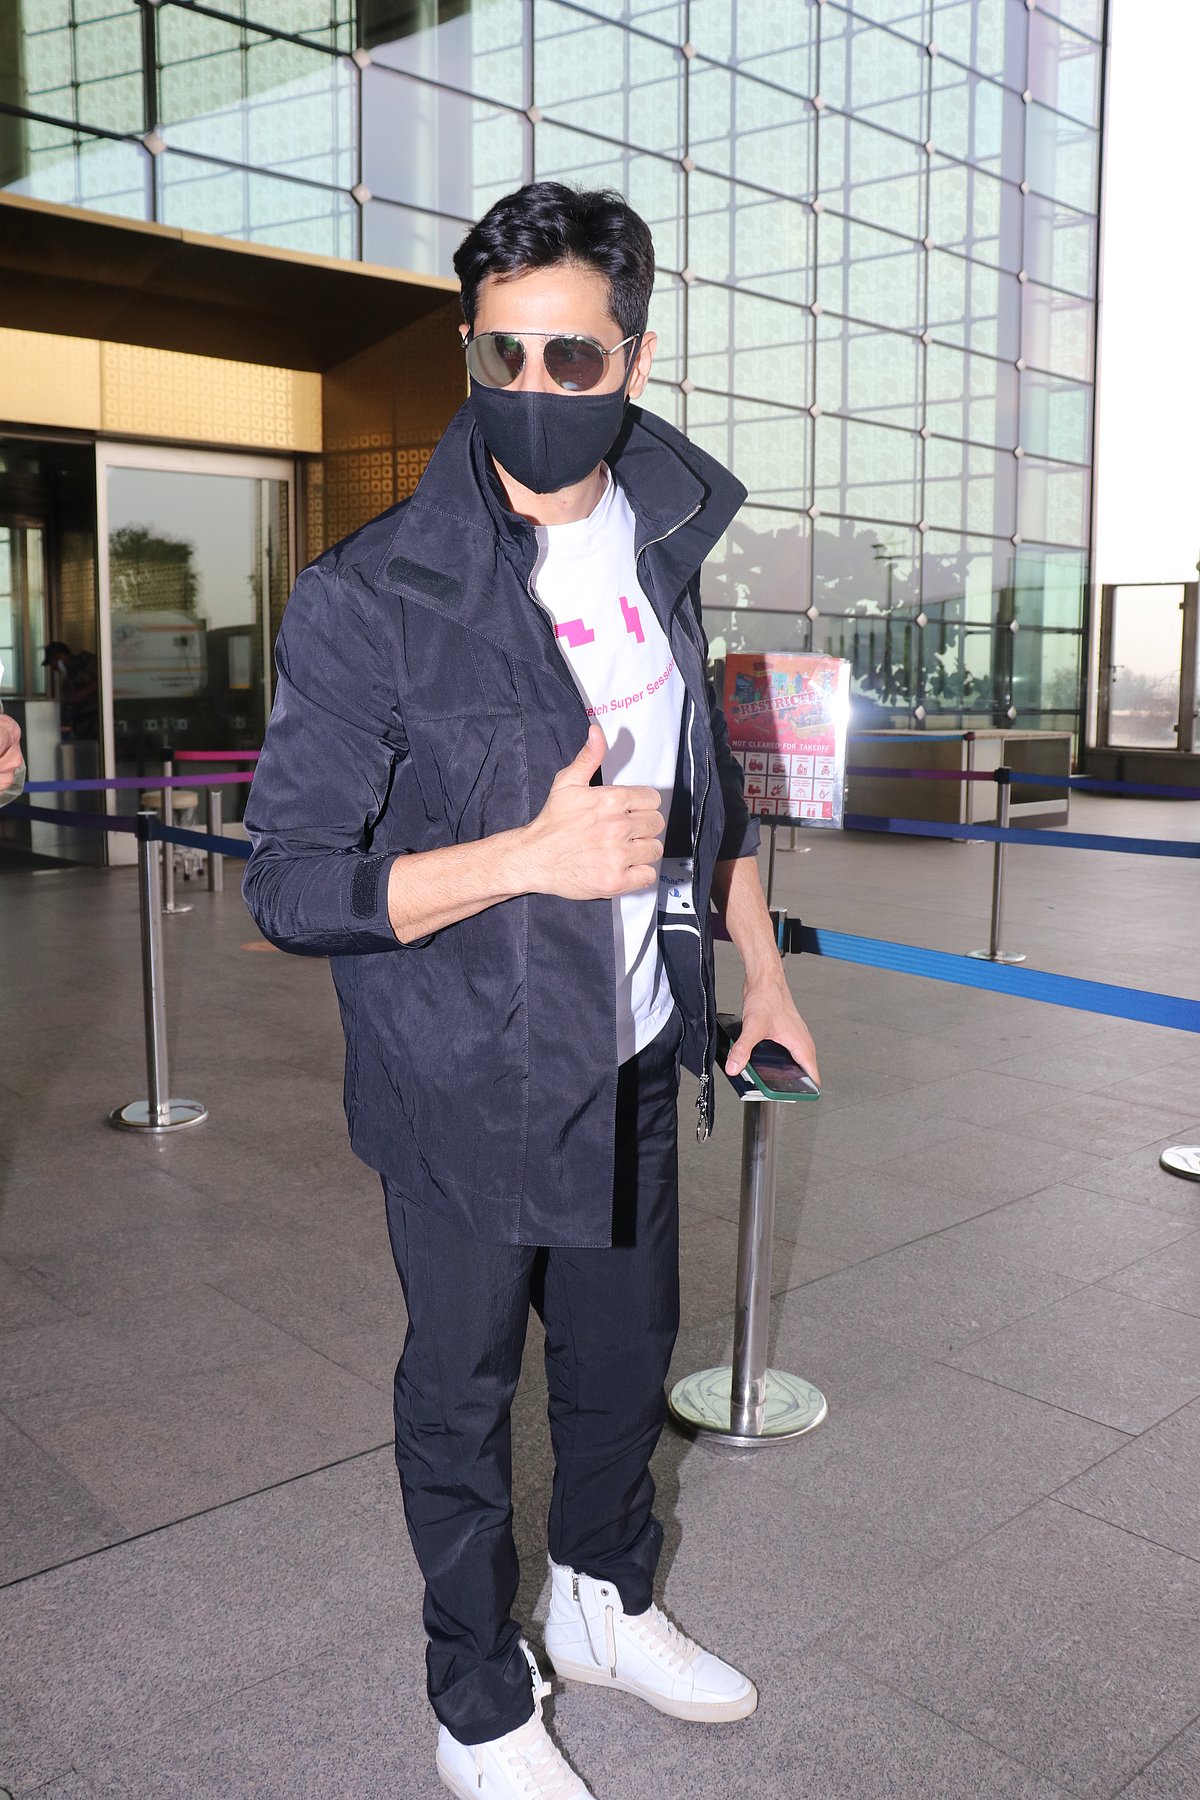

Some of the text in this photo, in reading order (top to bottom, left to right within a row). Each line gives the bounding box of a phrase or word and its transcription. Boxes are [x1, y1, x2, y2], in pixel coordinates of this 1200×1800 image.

[610, 691, 644, 711] Super
[740, 691, 819, 715] RESTRICTE
[748, 741, 779, 749] CLEARED
[782, 742, 797, 750] FOR
[799, 743, 831, 752] TAKEOFF
